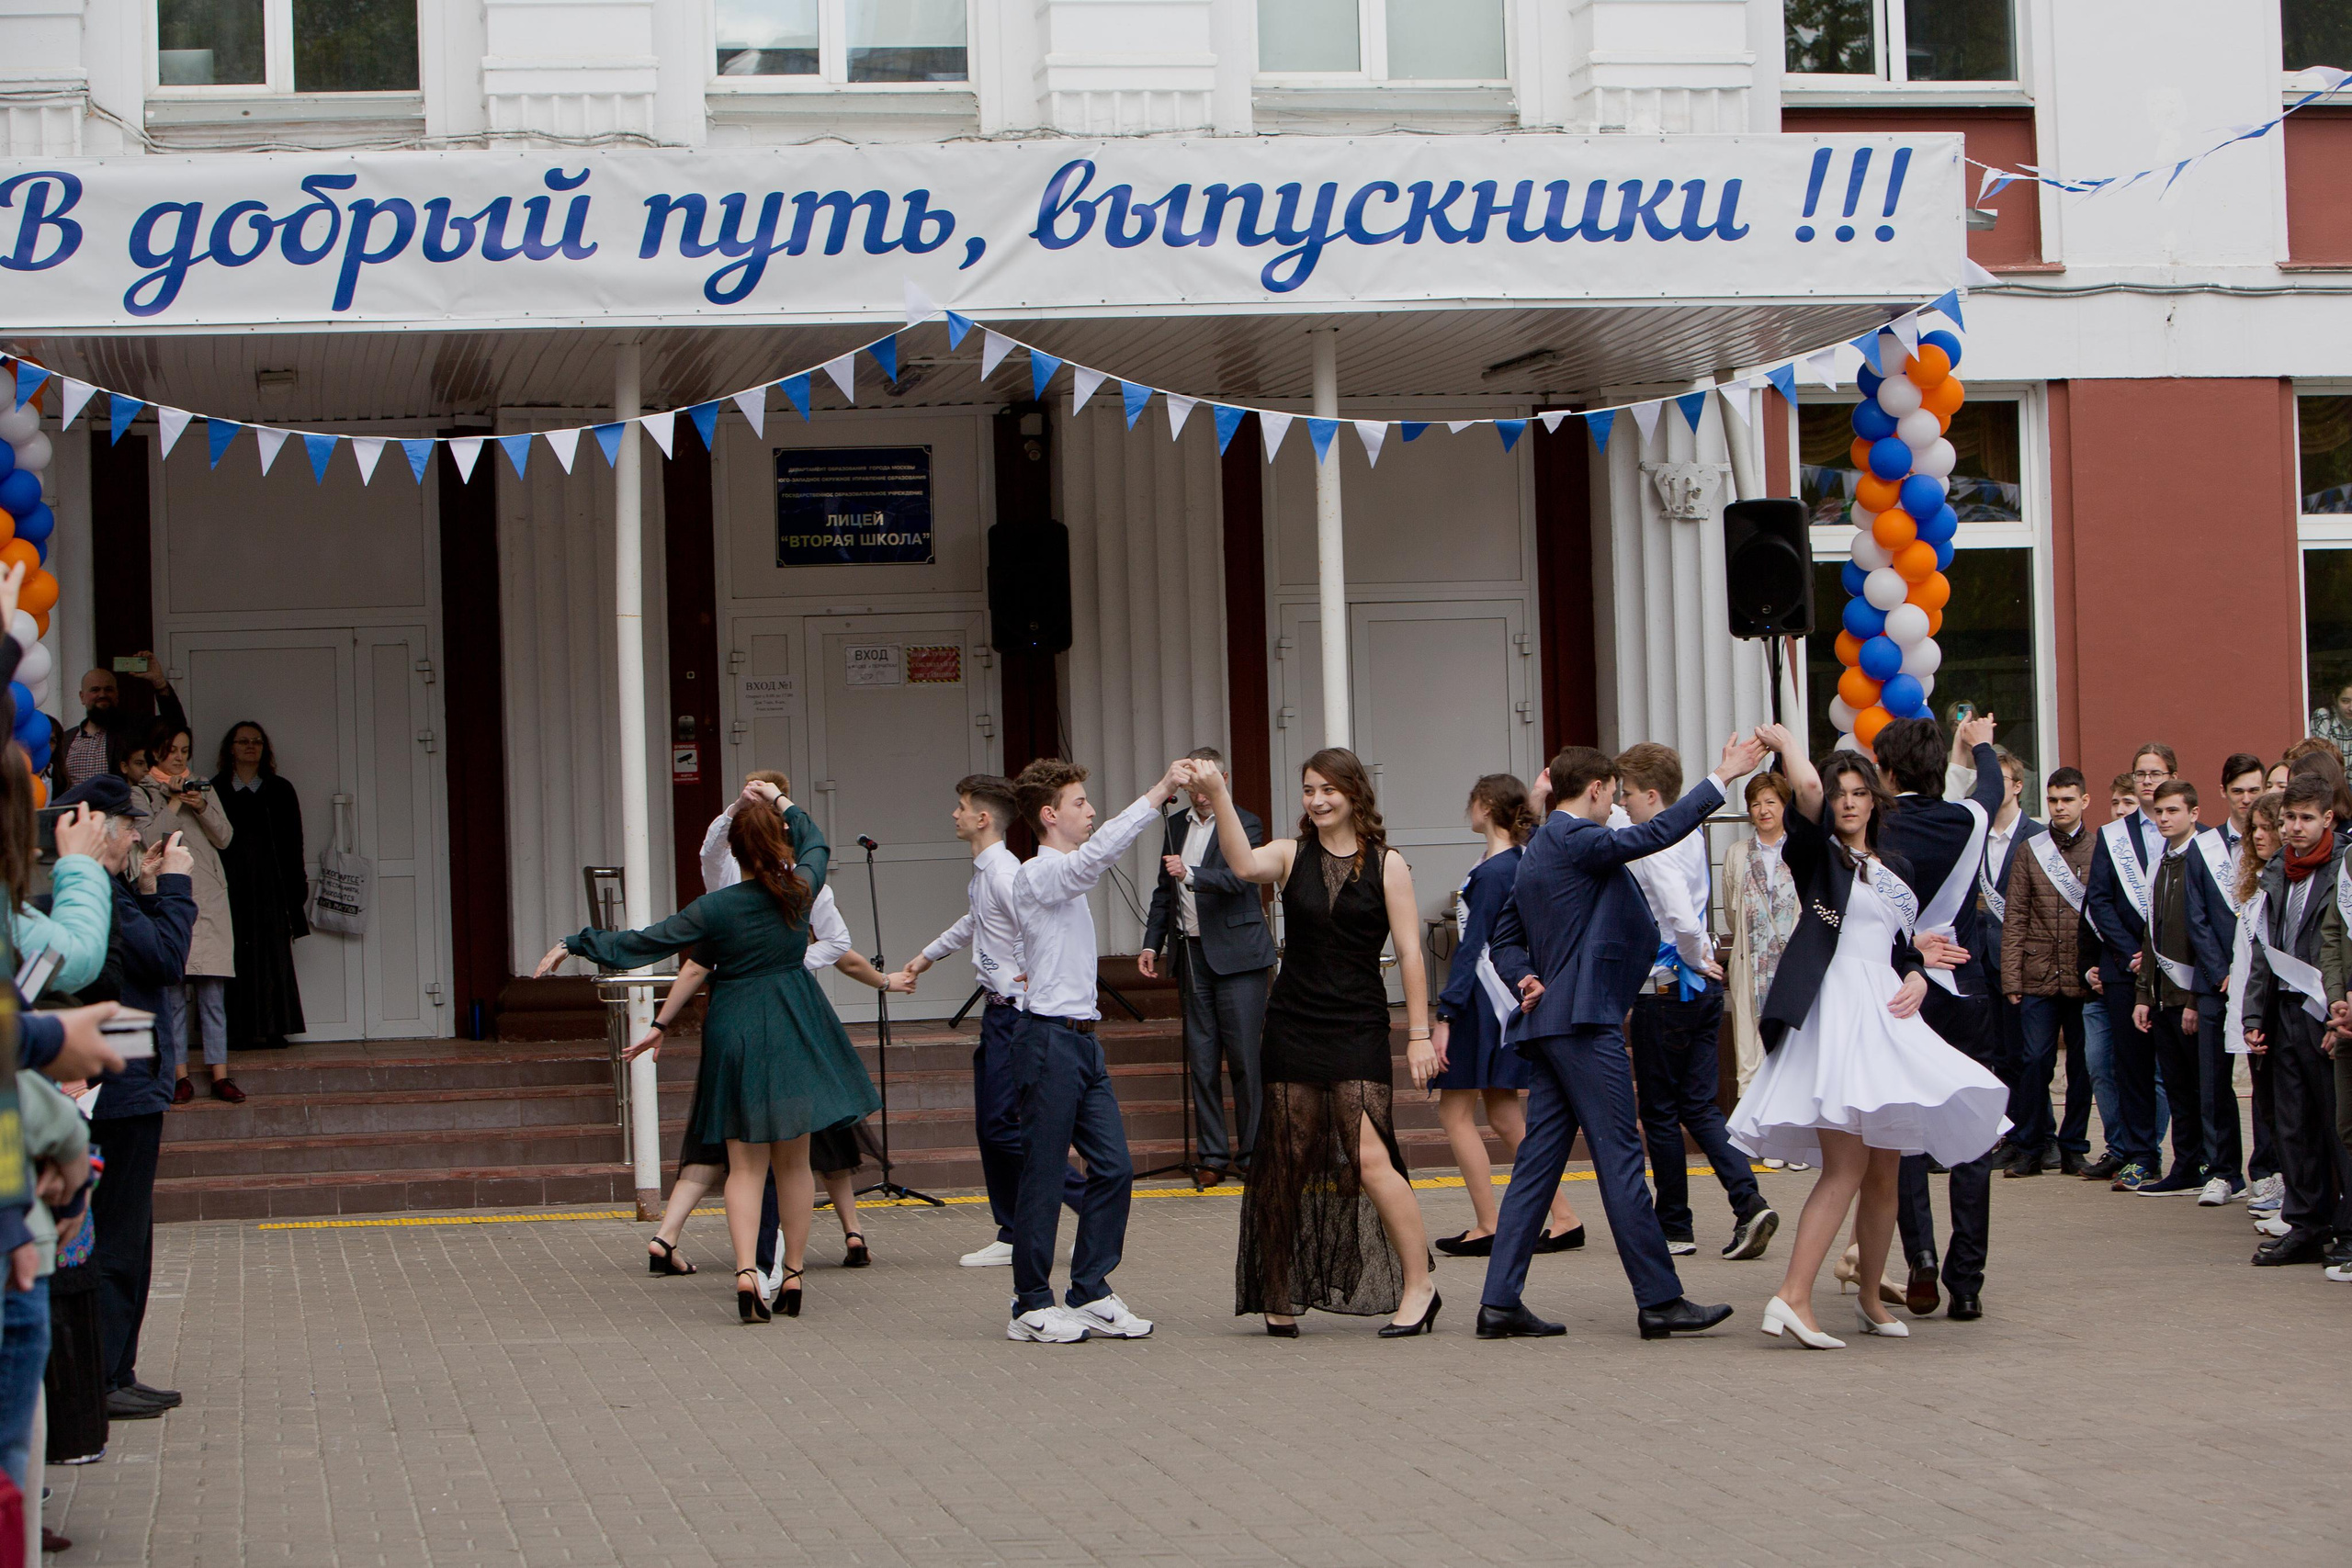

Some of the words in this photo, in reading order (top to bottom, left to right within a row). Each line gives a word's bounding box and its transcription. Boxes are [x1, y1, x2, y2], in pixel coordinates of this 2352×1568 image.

[0, 170, 84, 272] В
[123, 166, 599, 317] добрый
[639, 188, 987, 306] путь,
[1028, 158, 1750, 294] выпускники
[1794, 146, 1914, 243] !!!
[825, 511, 885, 529] ЛИЦЕЙ
[854, 649, 888, 661] ВХОД
[745, 681, 775, 691] ВХОД
[777, 681, 792, 690] №1
